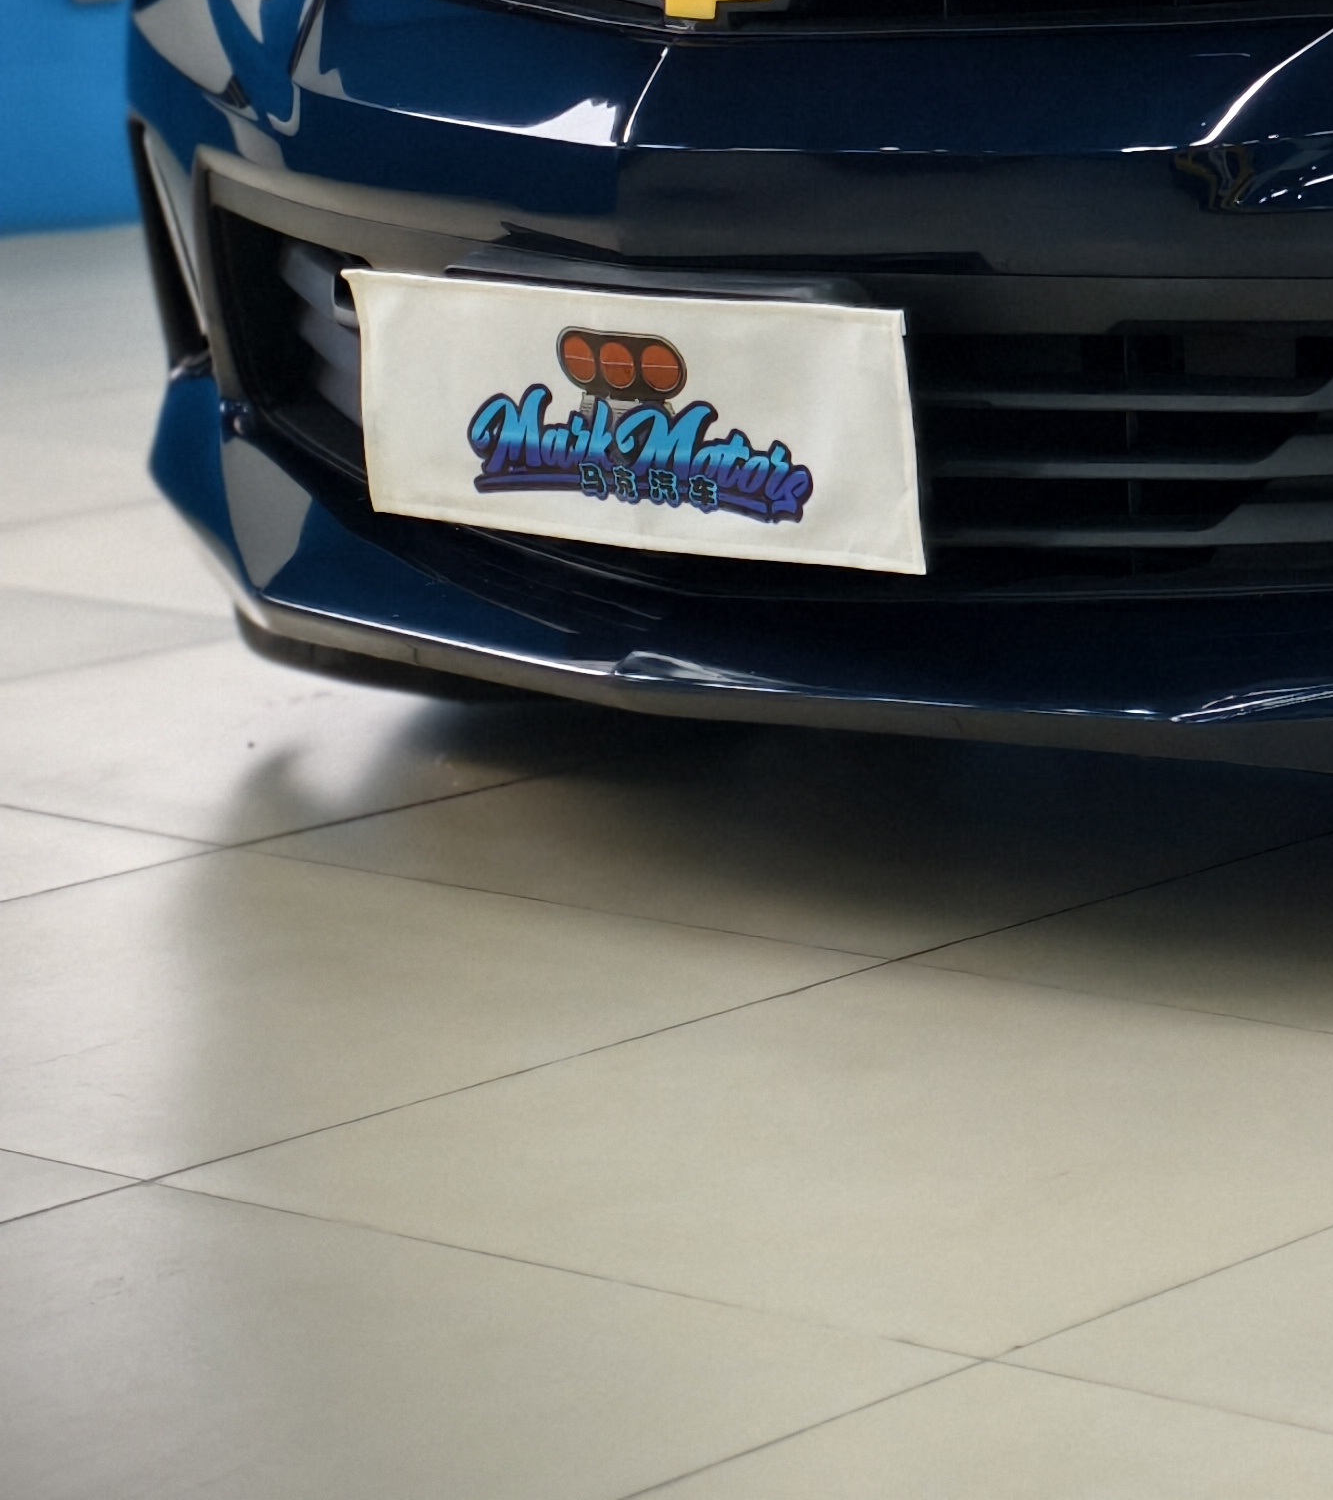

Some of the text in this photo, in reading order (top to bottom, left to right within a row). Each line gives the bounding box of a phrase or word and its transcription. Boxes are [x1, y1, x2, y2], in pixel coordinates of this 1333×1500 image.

[468, 384, 812, 520] Mark Motors
[579, 462, 719, 512] 马克汽车
